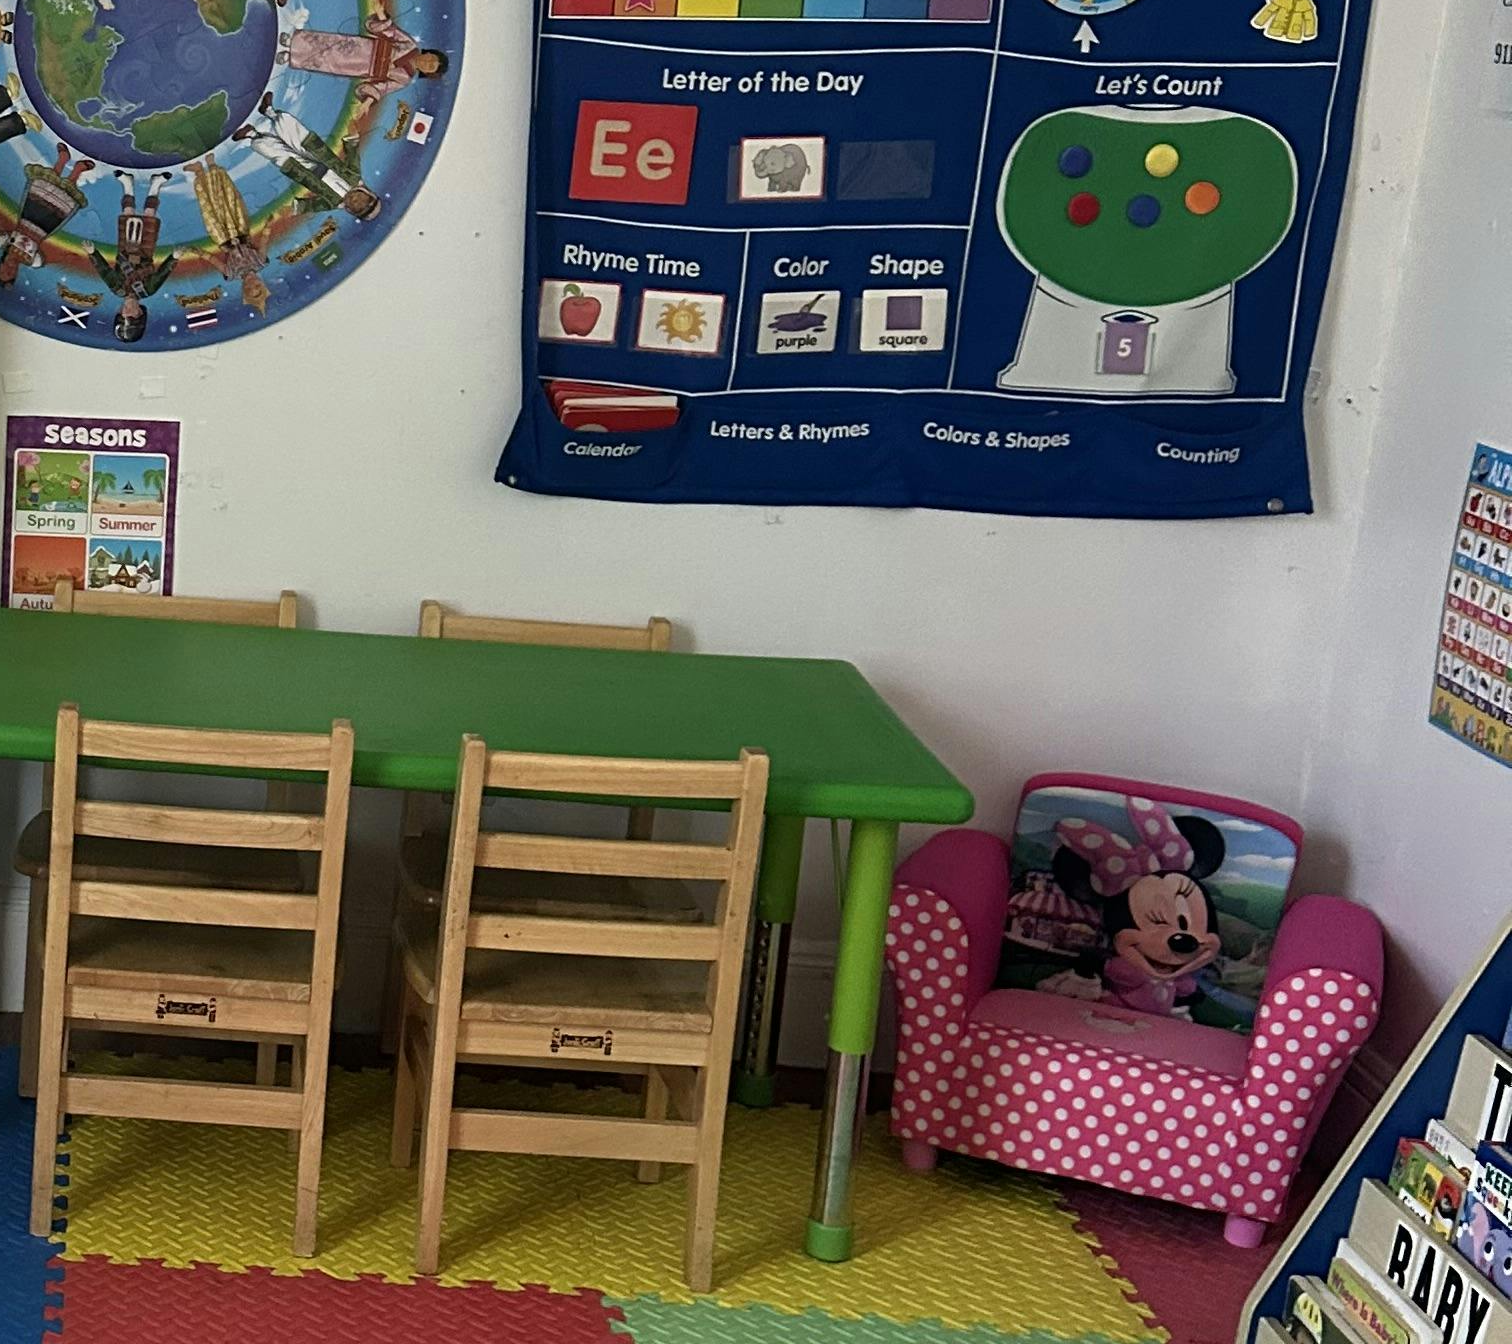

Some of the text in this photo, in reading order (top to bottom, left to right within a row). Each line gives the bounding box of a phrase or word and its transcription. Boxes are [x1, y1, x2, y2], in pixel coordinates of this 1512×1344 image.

[662, 68, 864, 96] Letter of the Day
[1095, 74, 1223, 97] Let's Count
[589, 119, 676, 180] Ee
[563, 244, 945, 281] Rhyme Time Color Shape
[776, 333, 928, 350] purple square
[1117, 339, 1132, 357] 5
[710, 421, 870, 443] Letters & Rhymes
[924, 422, 1071, 451] Colors & Shapes
[563, 441, 642, 458] Calendar
[1157, 442, 1240, 464] Counting
[27, 514, 157, 532] Spring Summer
